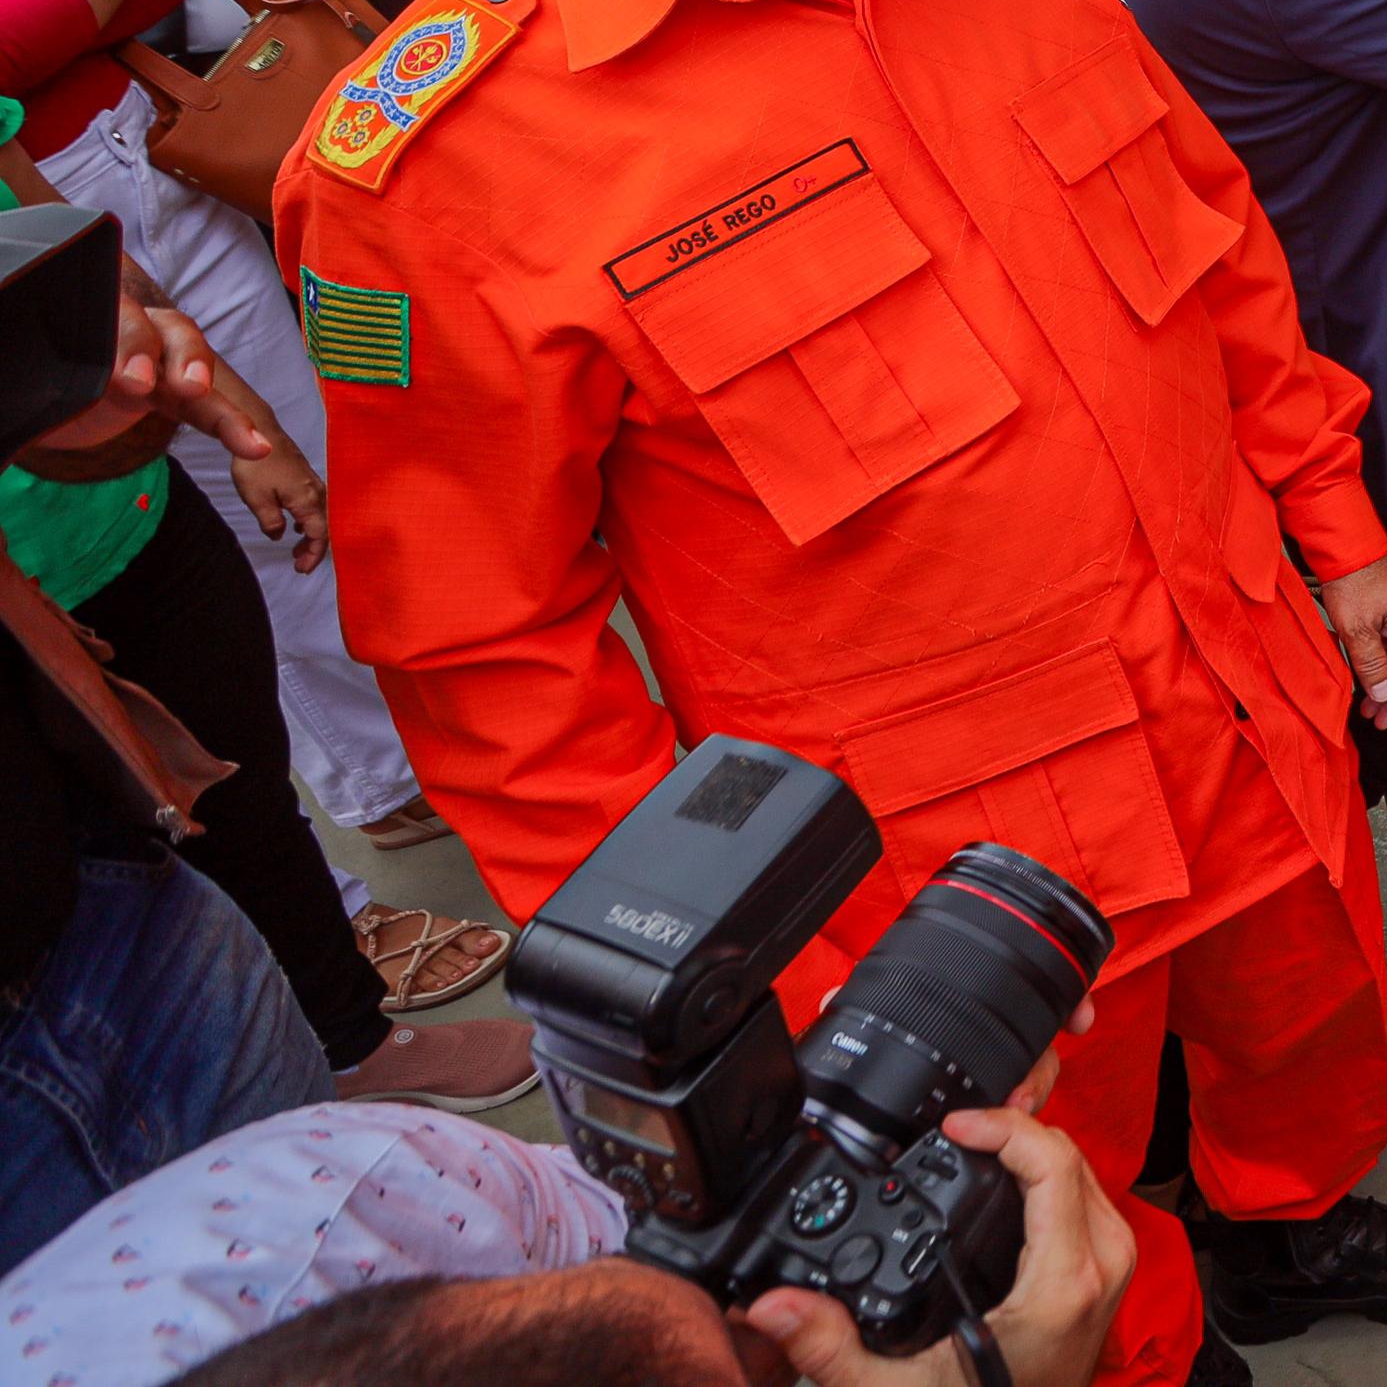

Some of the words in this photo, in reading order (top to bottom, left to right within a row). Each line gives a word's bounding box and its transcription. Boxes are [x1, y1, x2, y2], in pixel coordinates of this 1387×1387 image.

[665, 220, 719, 263] JOSÉ
[722, 194, 777, 231] REGO
[831, 1031, 869, 1056] Canon
